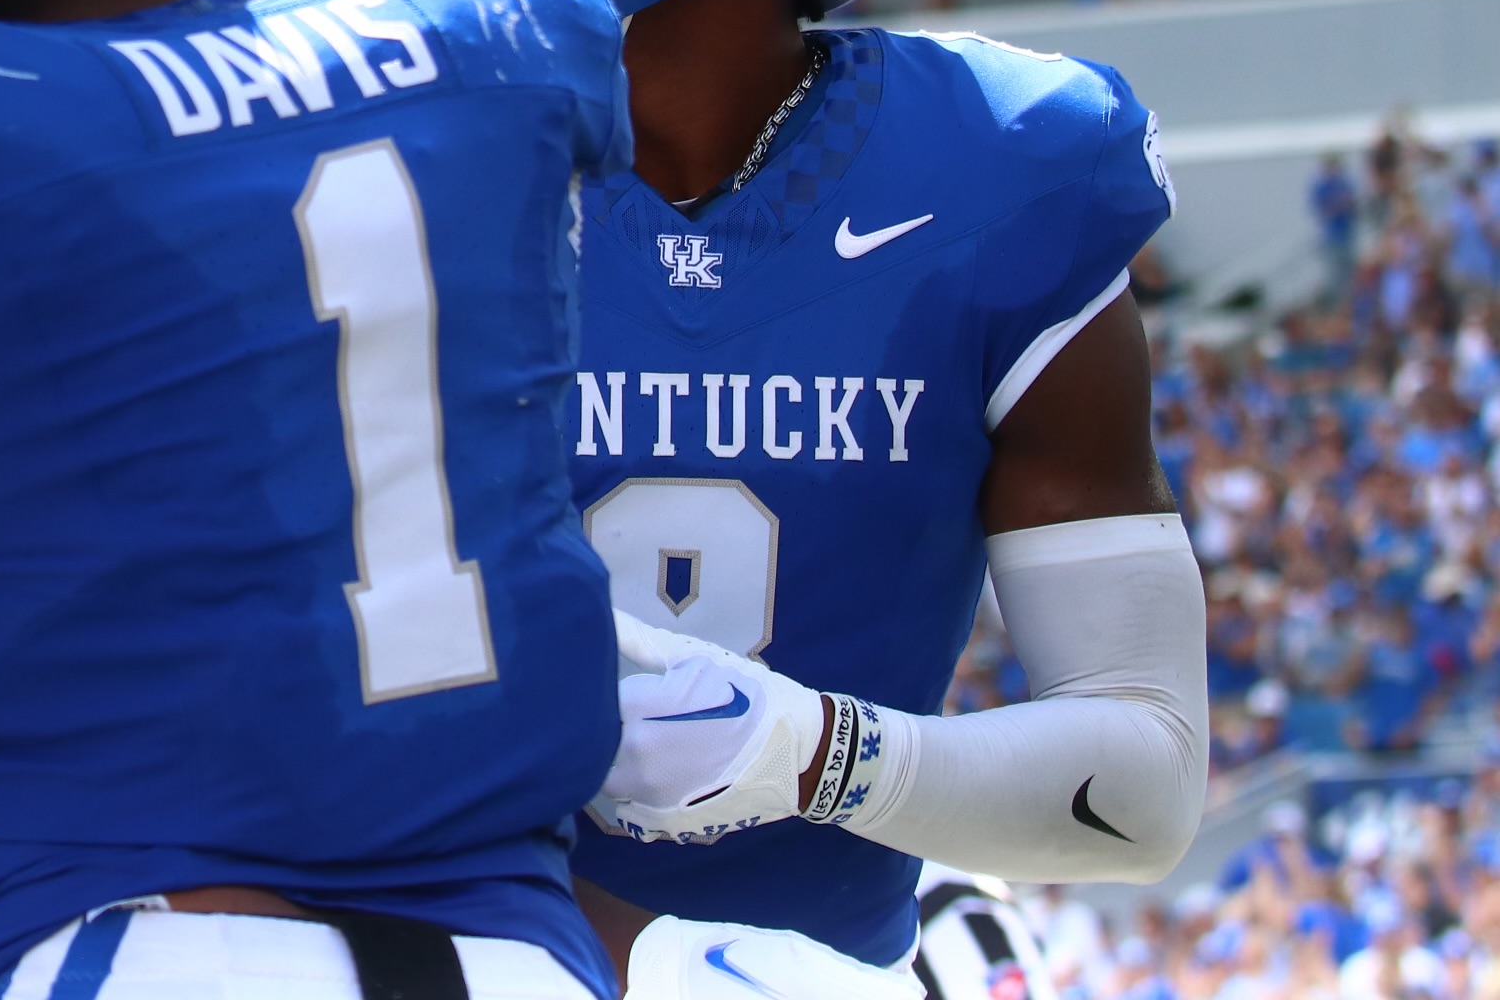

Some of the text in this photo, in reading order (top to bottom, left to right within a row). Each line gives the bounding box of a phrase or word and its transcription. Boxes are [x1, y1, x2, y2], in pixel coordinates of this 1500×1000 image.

[657, 234, 723, 289] UK
[292, 136, 498, 705] 1
[576, 372, 925, 462] NTUCKY
[827, 749, 845, 771] DO
